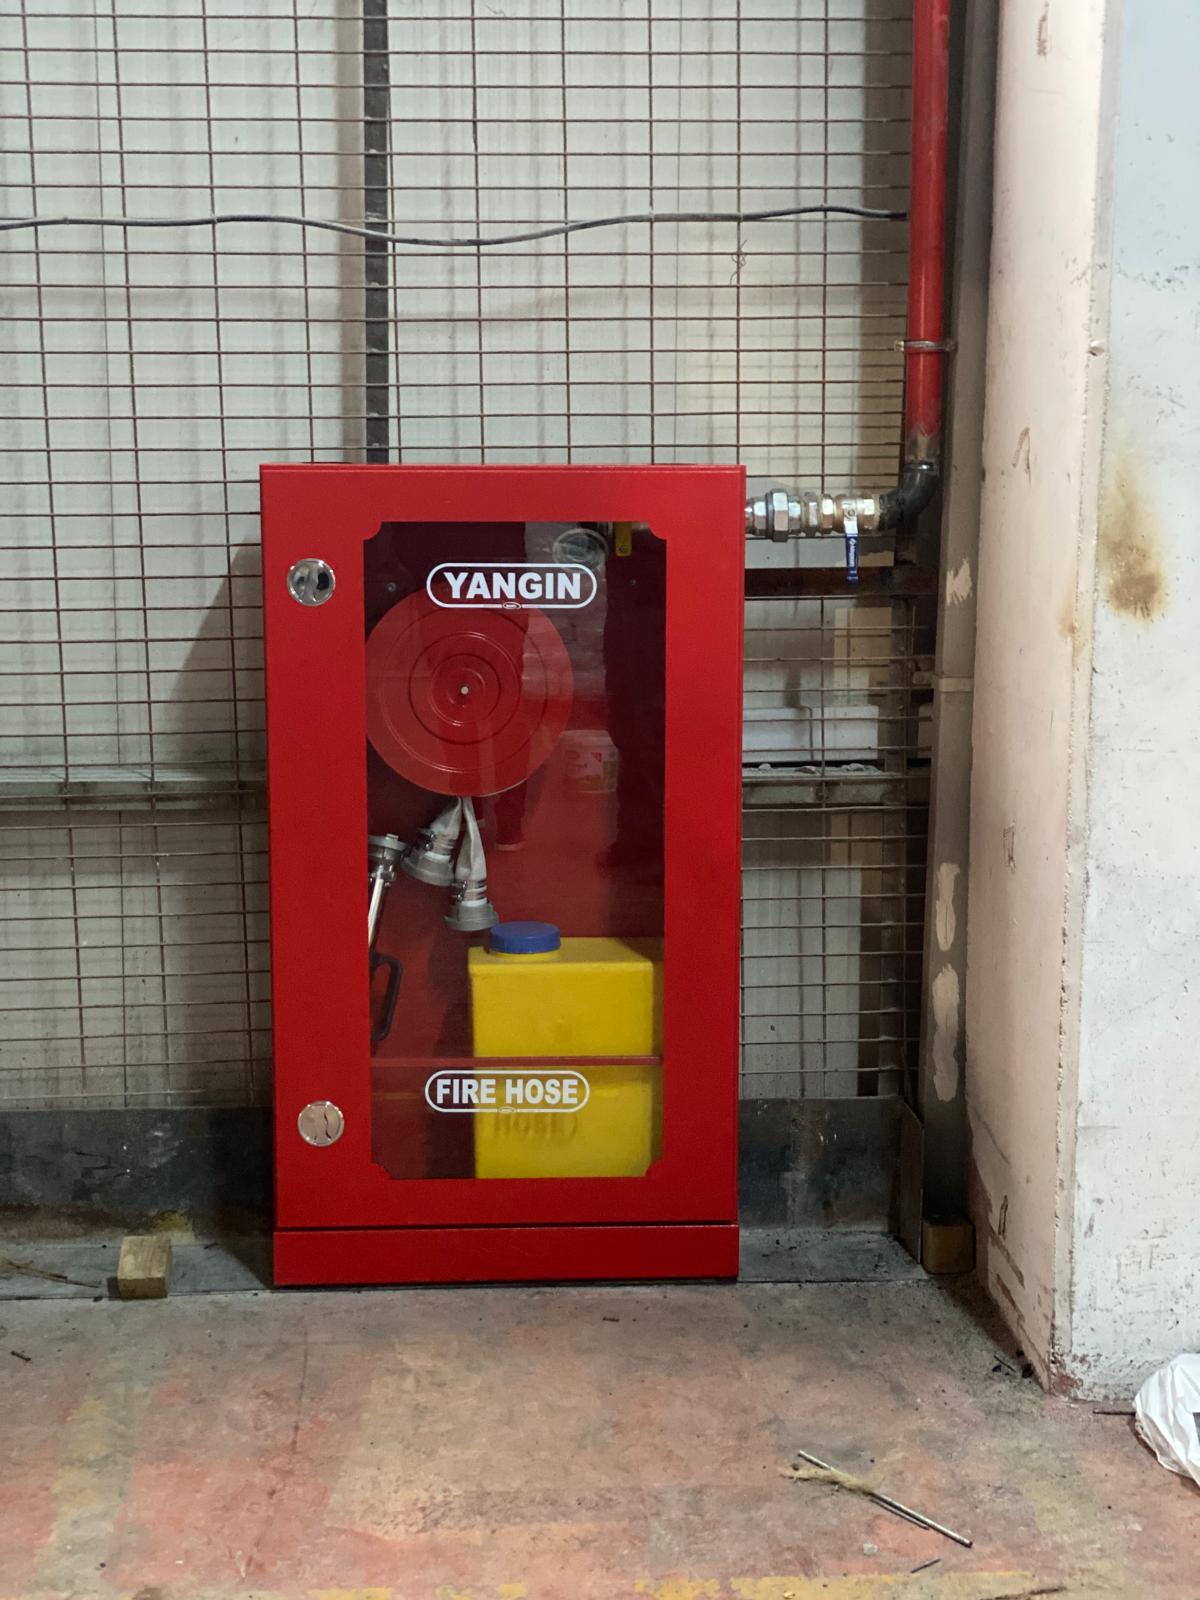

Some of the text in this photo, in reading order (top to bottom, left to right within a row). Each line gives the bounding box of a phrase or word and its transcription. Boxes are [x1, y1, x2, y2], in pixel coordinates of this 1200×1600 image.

[443, 572, 581, 600] YANGIN
[436, 1078, 578, 1105] FIRE HOSE
